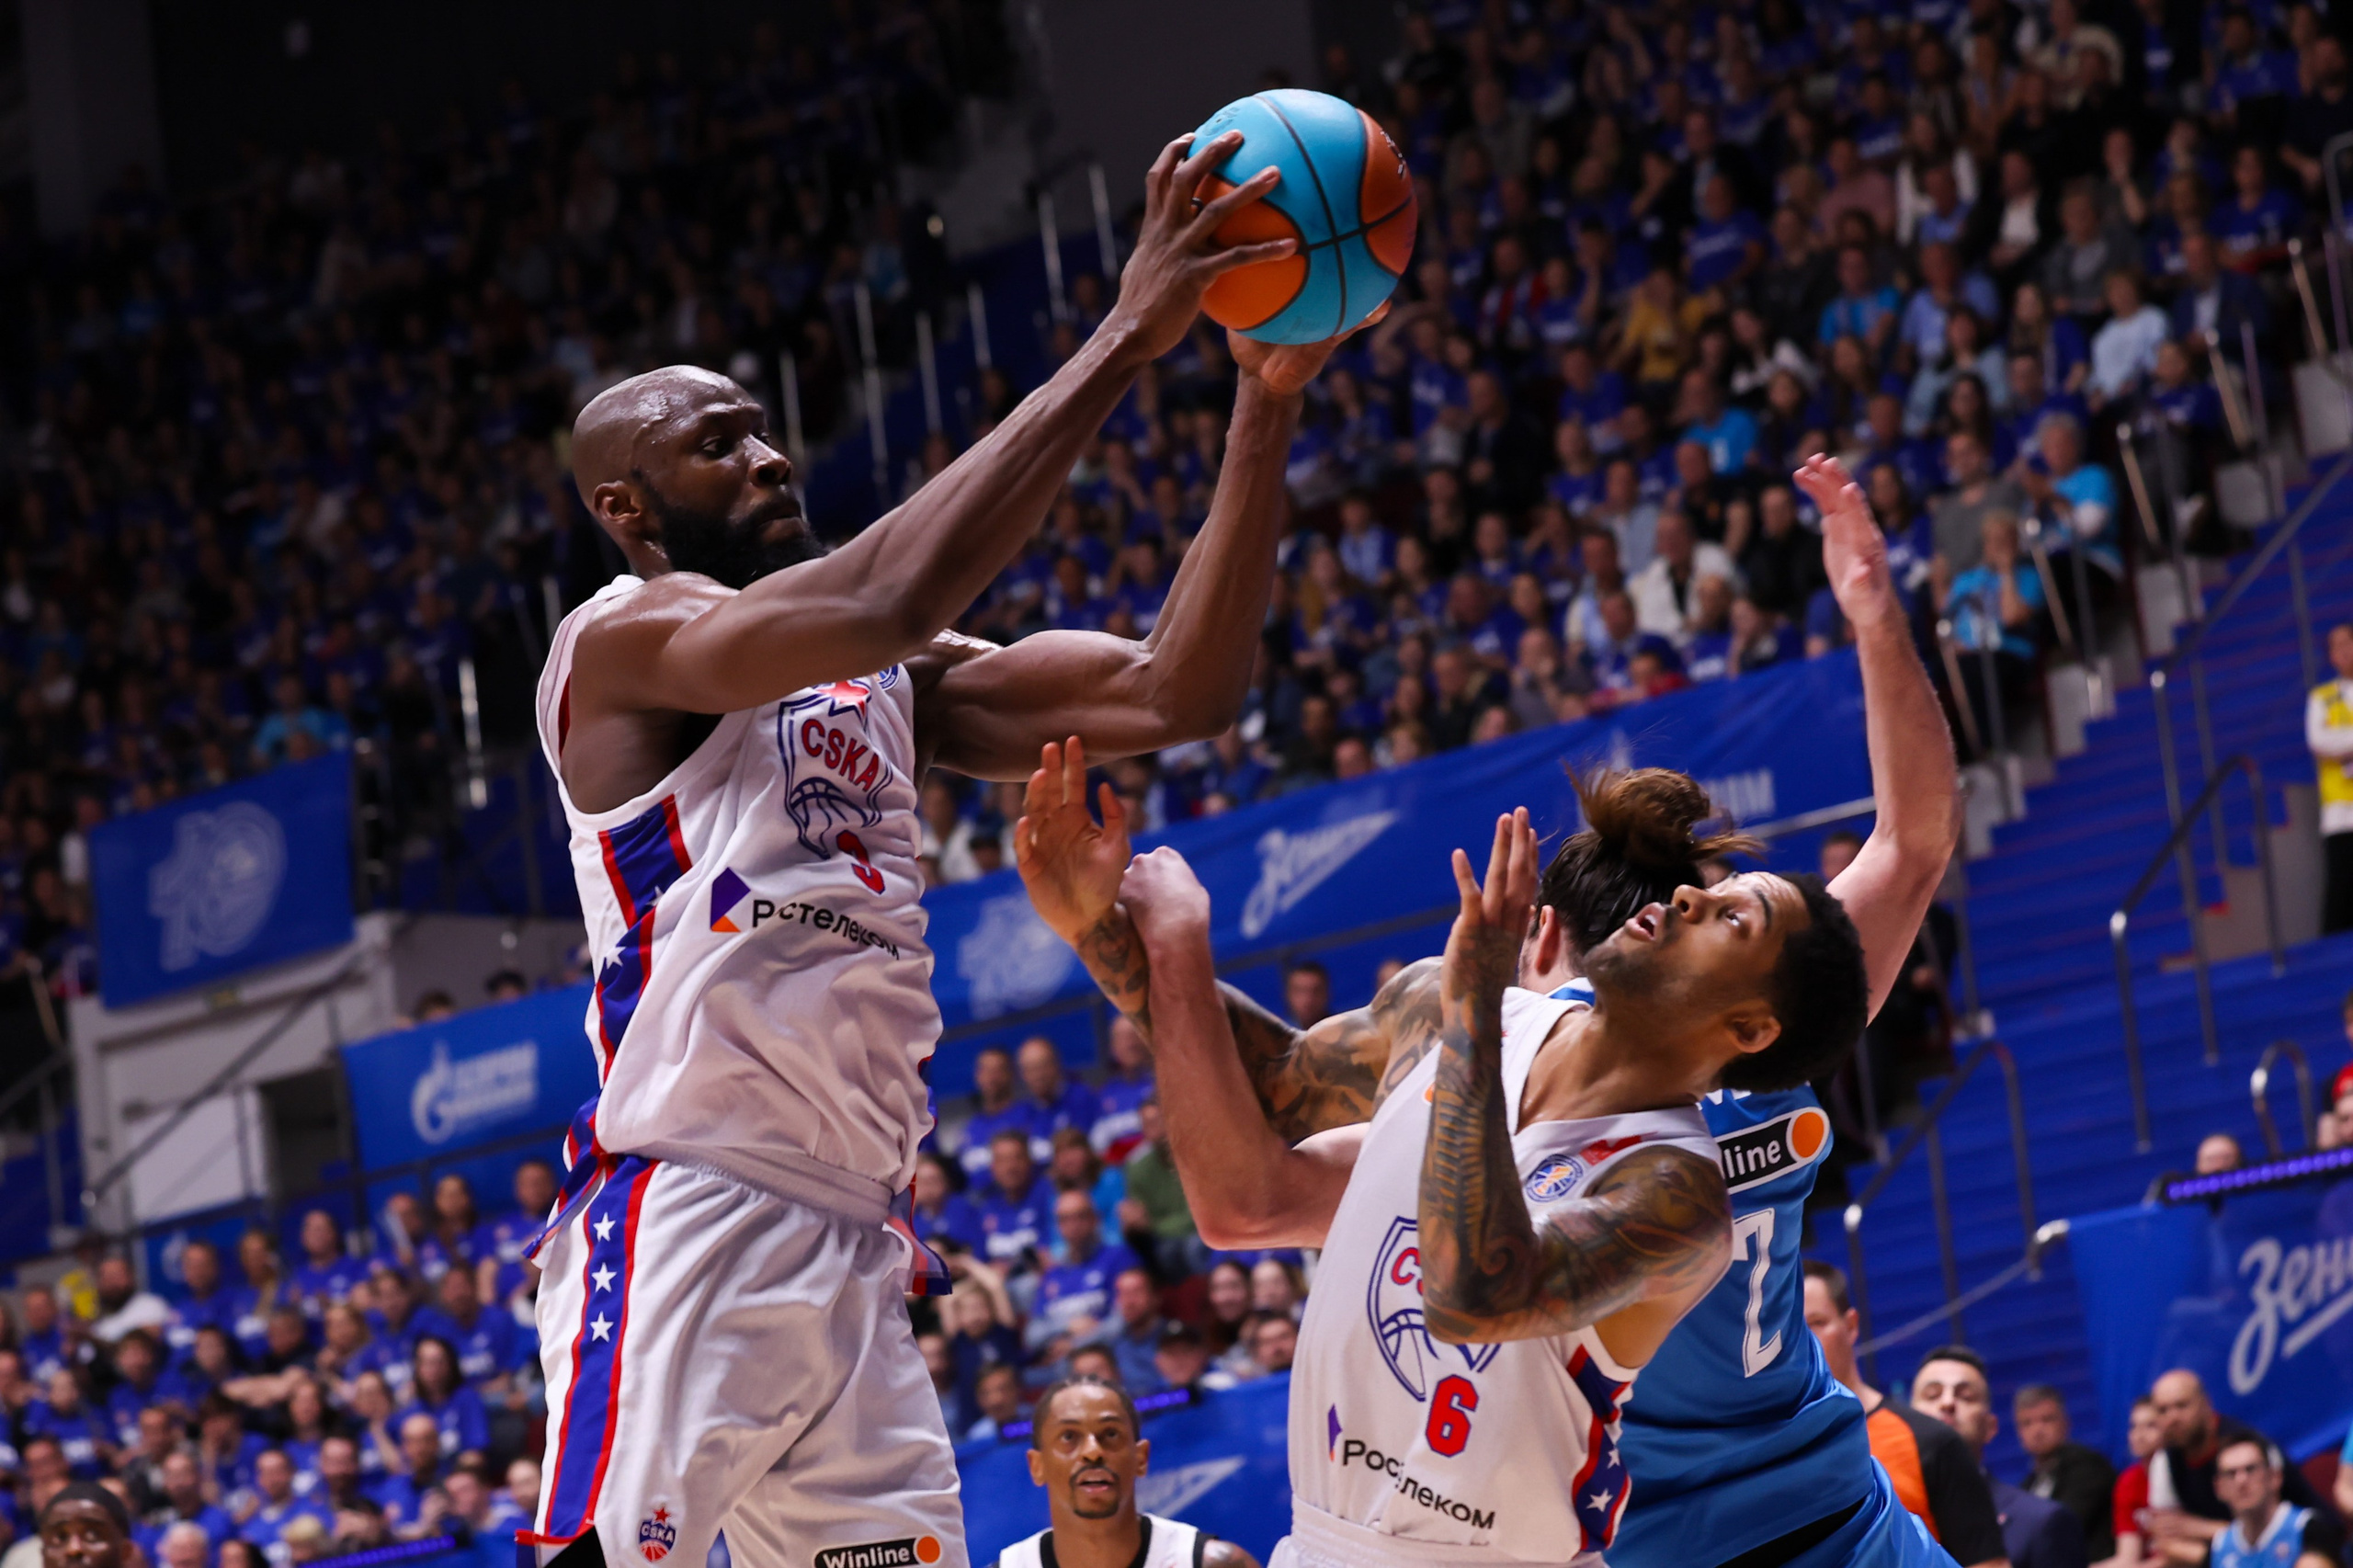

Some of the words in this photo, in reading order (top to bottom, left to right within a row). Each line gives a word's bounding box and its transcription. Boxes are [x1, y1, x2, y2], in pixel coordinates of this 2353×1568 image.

[801, 718, 880, 792] CSKA
[835, 829, 886, 895] 3
[1722, 1139, 1781, 1178] line
[2228, 1237, 2353, 1396] Зен
[1425, 1374, 1479, 1458] 6
[641, 1523, 674, 1543] CSKA
[822, 1546, 911, 1568] Winline
